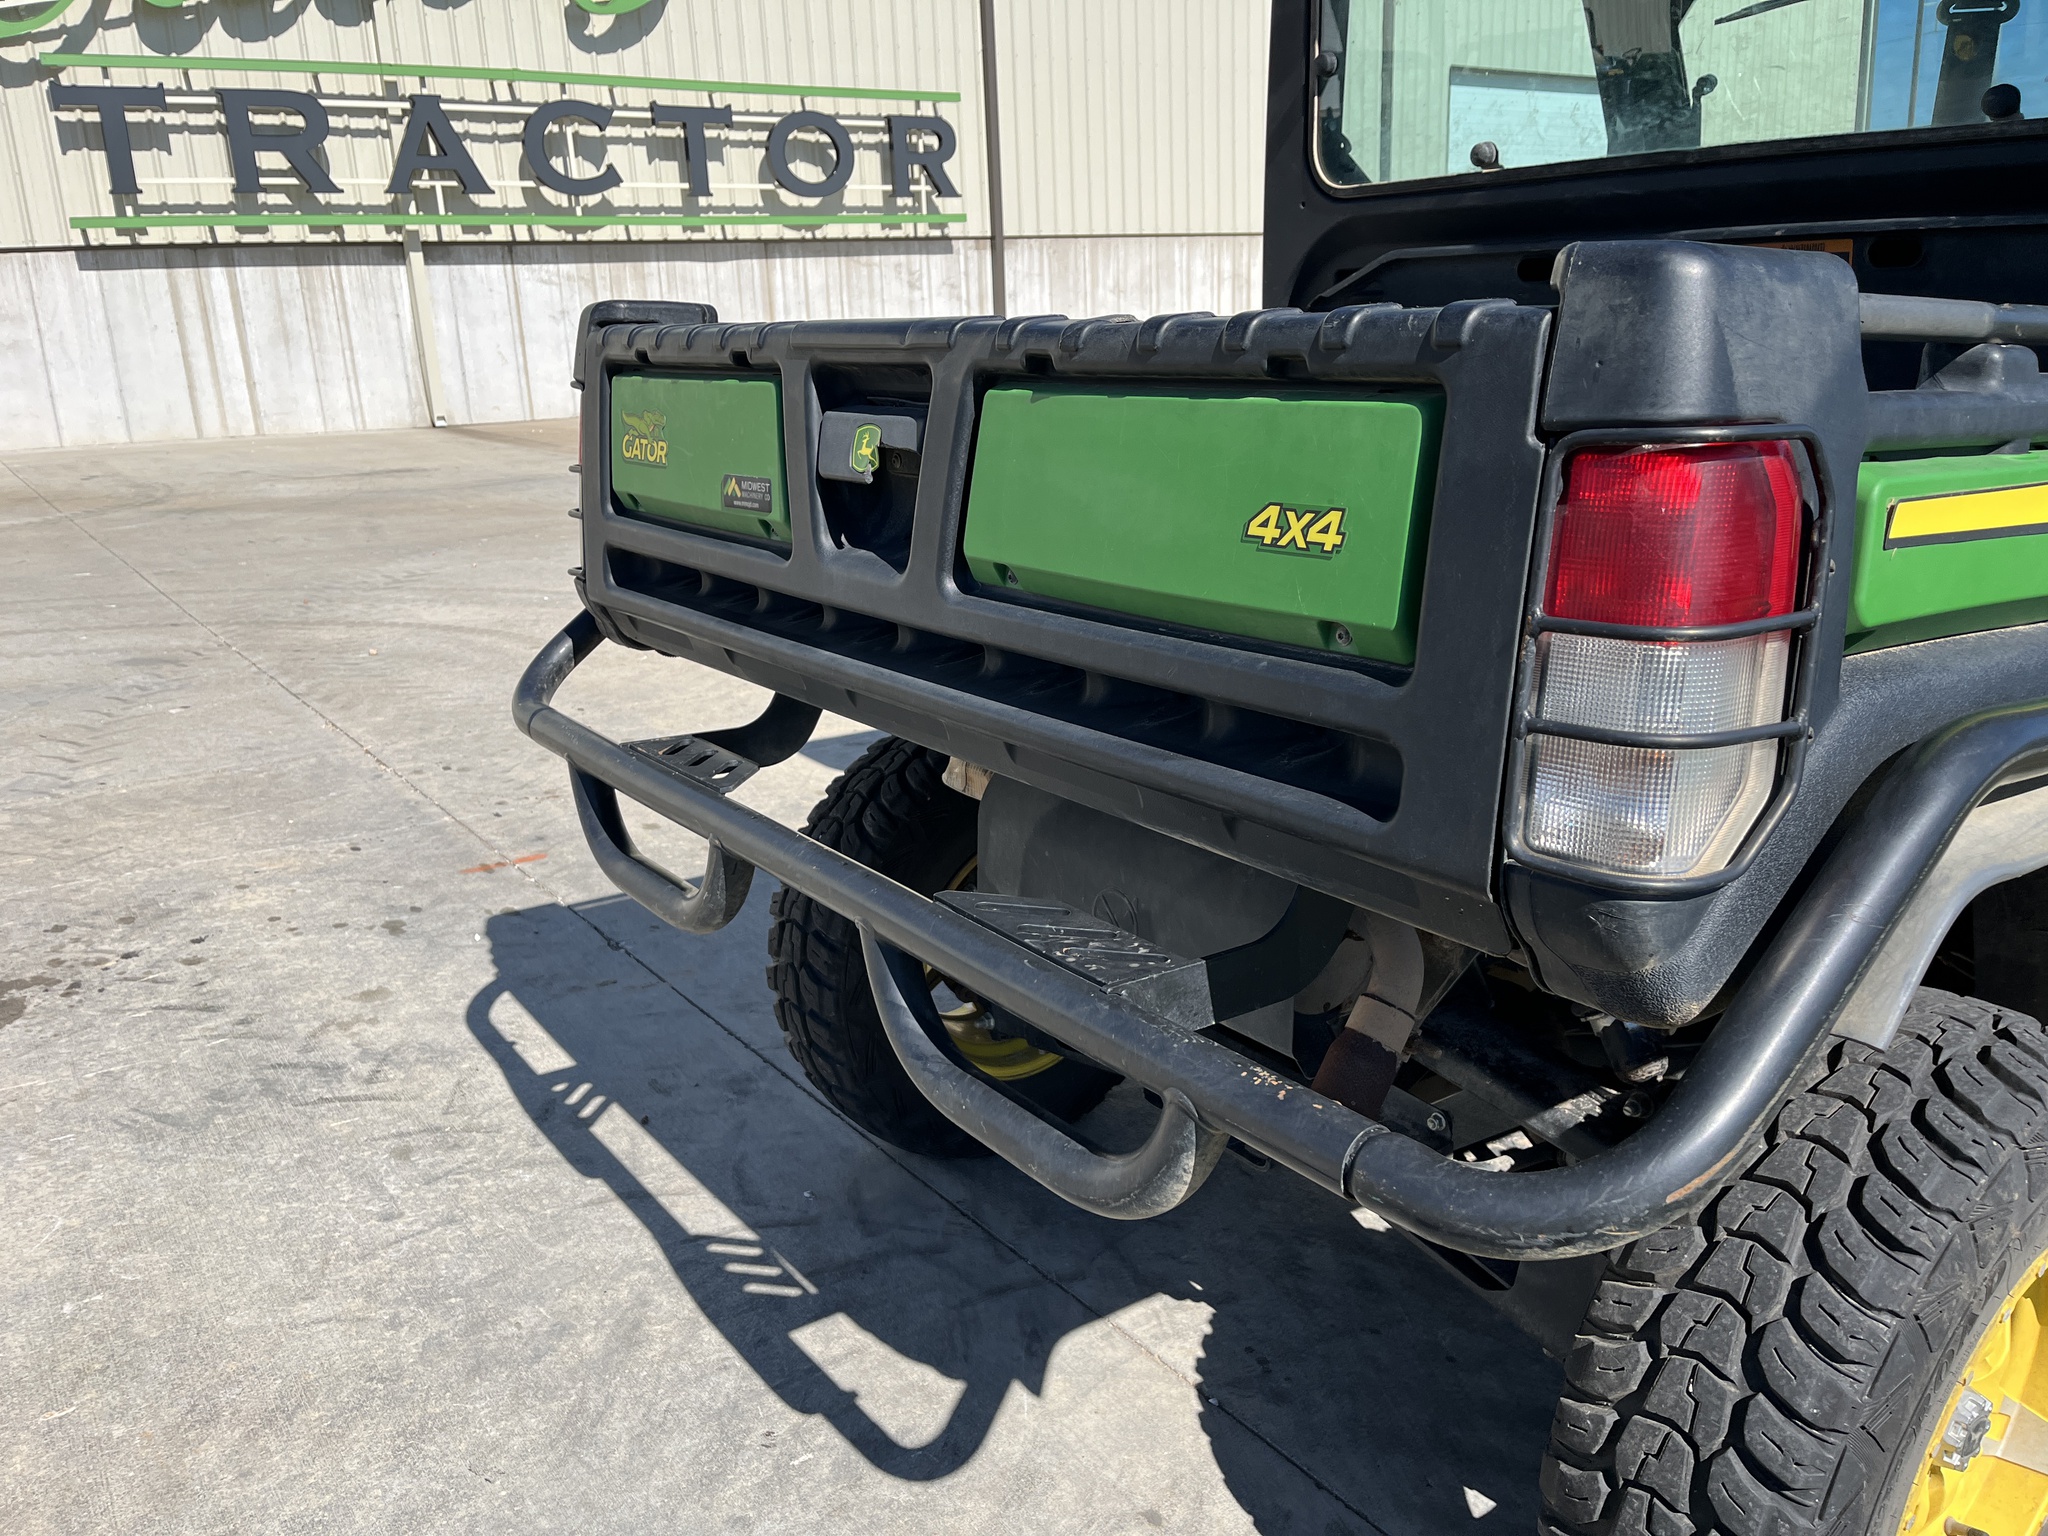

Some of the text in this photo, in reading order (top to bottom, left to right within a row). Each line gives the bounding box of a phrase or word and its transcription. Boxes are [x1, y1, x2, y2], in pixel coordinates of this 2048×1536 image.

[49, 79, 962, 199] TRACTOR
[622, 433, 668, 465] GATOR
[741, 480, 771, 493] MIDWEST
